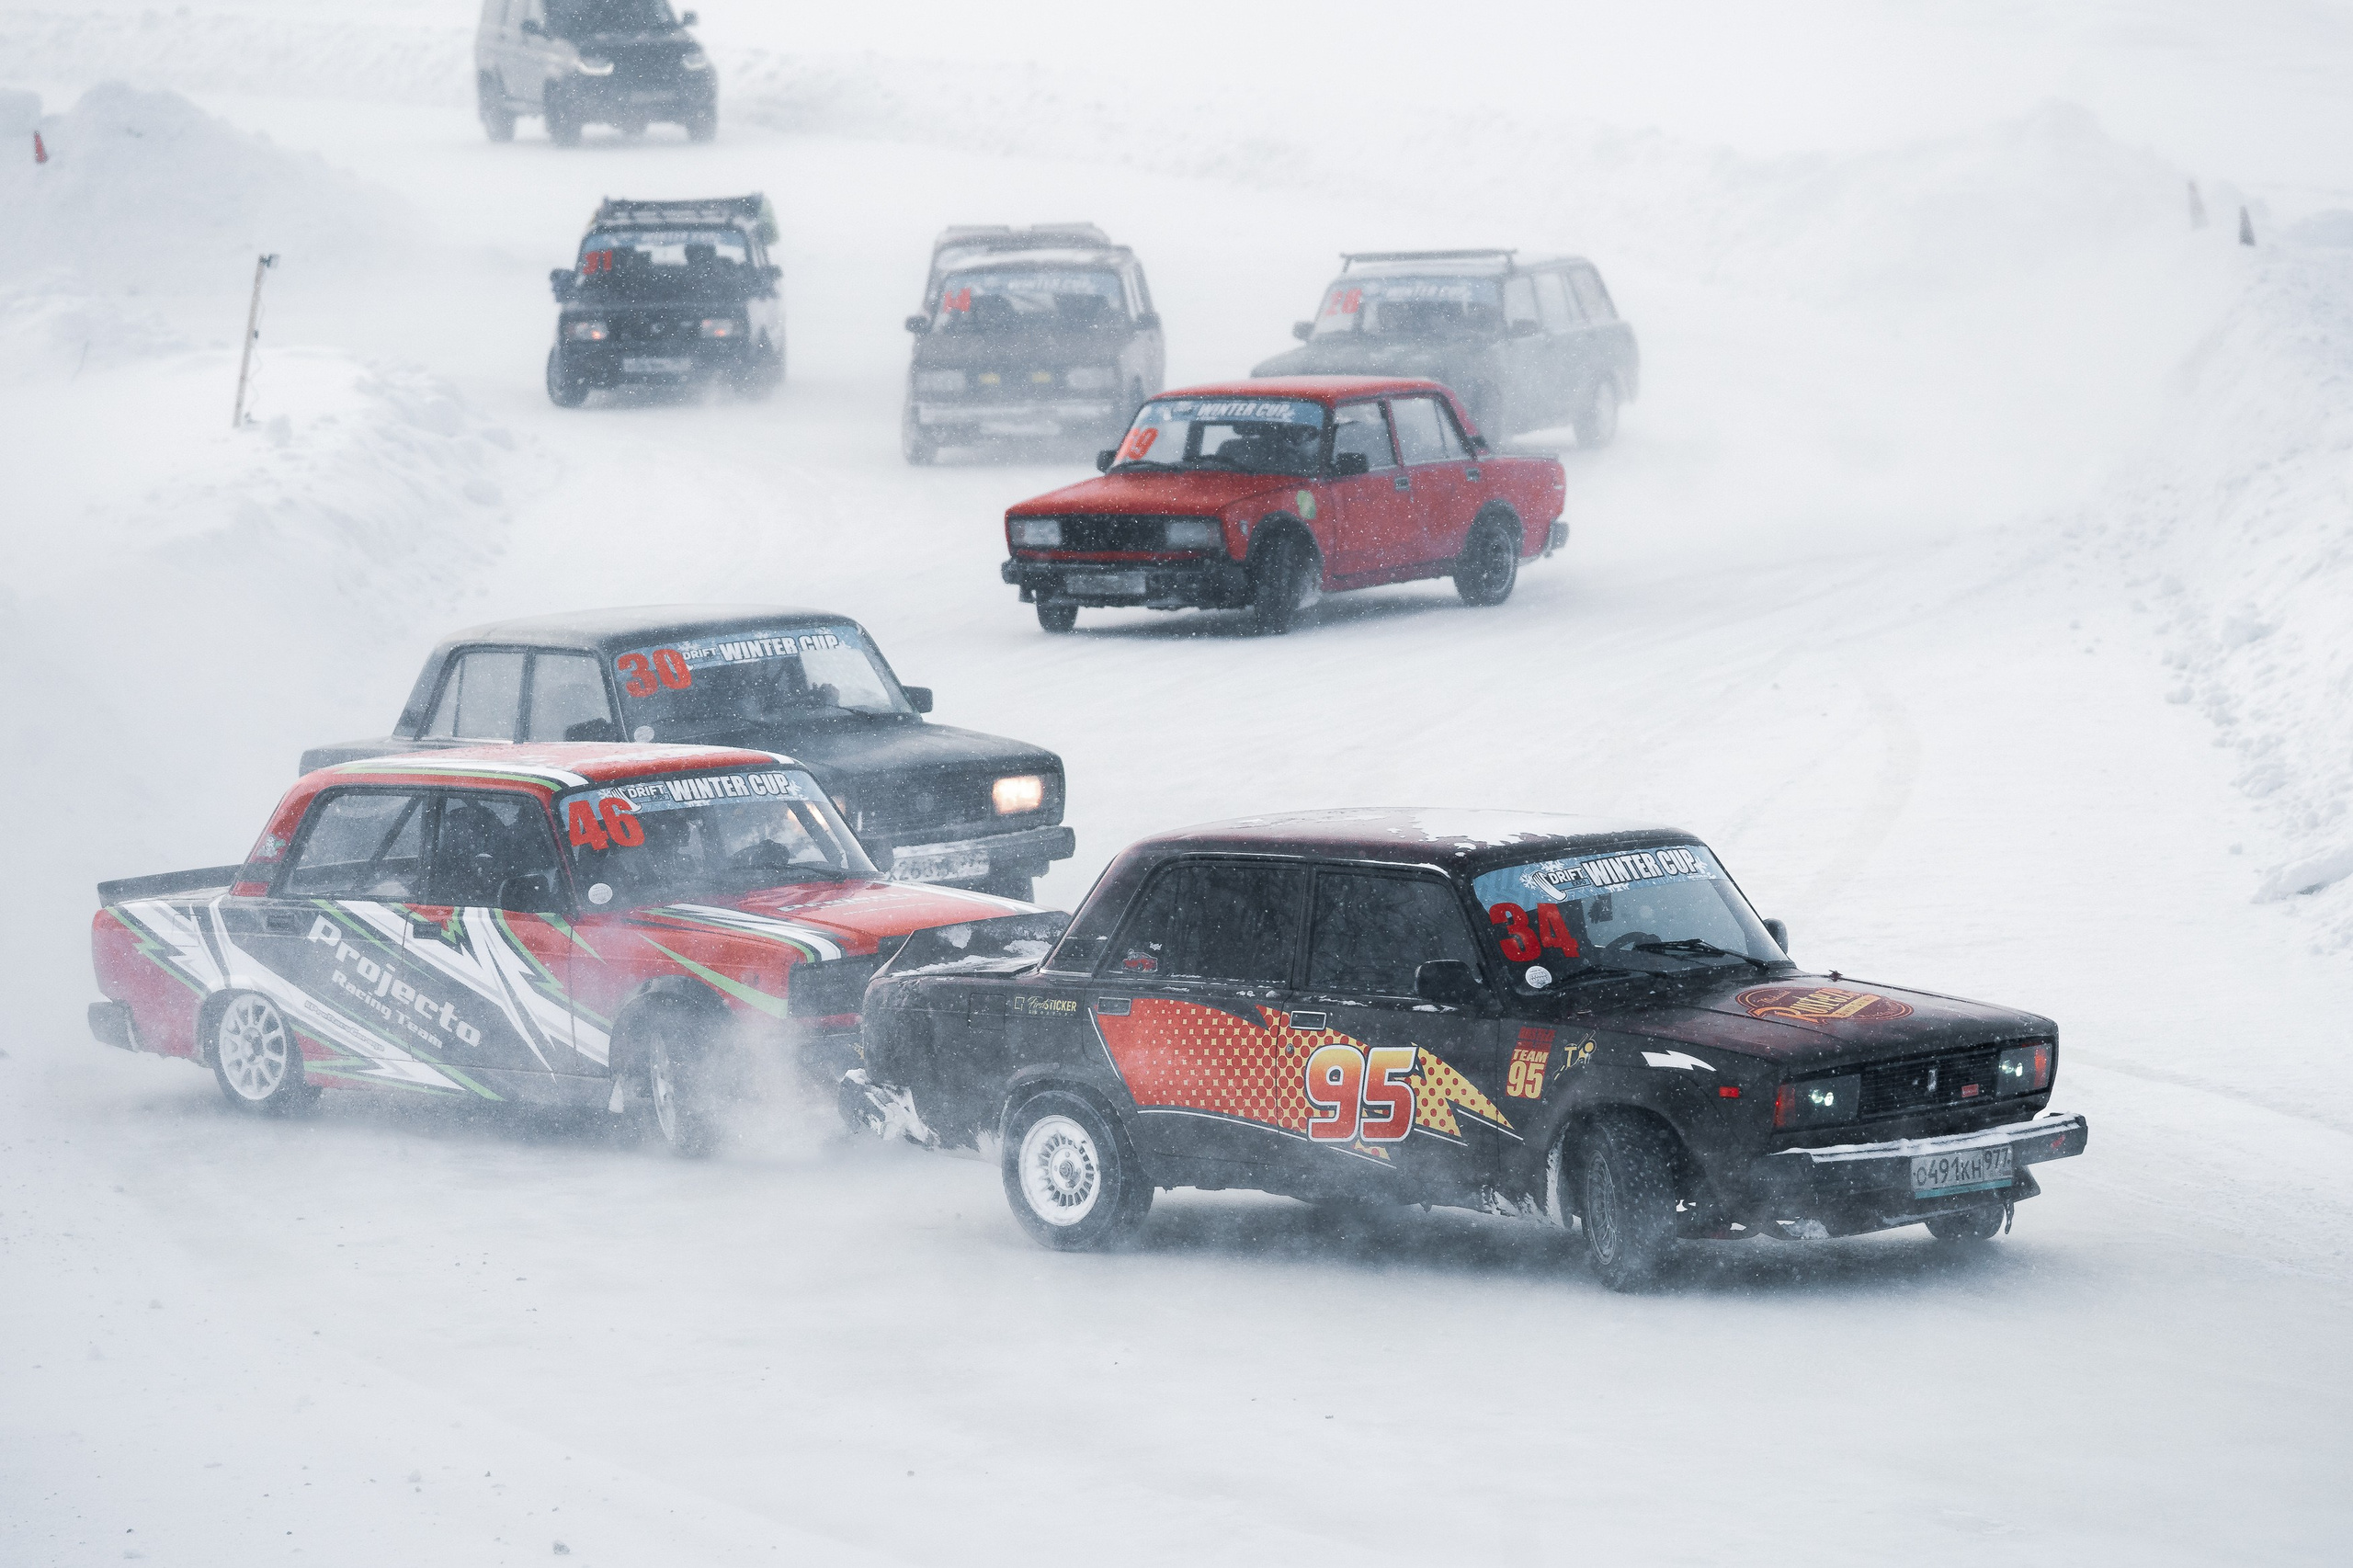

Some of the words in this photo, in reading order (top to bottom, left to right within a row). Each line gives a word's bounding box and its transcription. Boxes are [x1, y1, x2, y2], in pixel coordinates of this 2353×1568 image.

[1198, 403, 1257, 418] WINTER
[683, 647, 717, 661] DRIFT
[718, 636, 799, 662] WINTER
[798, 633, 840, 652] CUP
[617, 648, 692, 699] 30
[628, 784, 666, 799] DRIFT
[665, 774, 747, 803] WINTER
[747, 772, 790, 796] CUP
[568, 797, 645, 851] 46
[1547, 867, 1583, 884] DRIFT
[1581, 852, 1664, 888] WINTER
[1656, 847, 1698, 876] CUP
[1488, 902, 1580, 962] 34
[307, 914, 482, 1048] Projecto
[331, 969, 392, 1020] Racing
[395, 1009, 443, 1049] Team
[1512, 1048, 1550, 1063] TEAM
[1305, 1044, 1417, 1142] 95
[1506, 1060, 1545, 1099] 95
